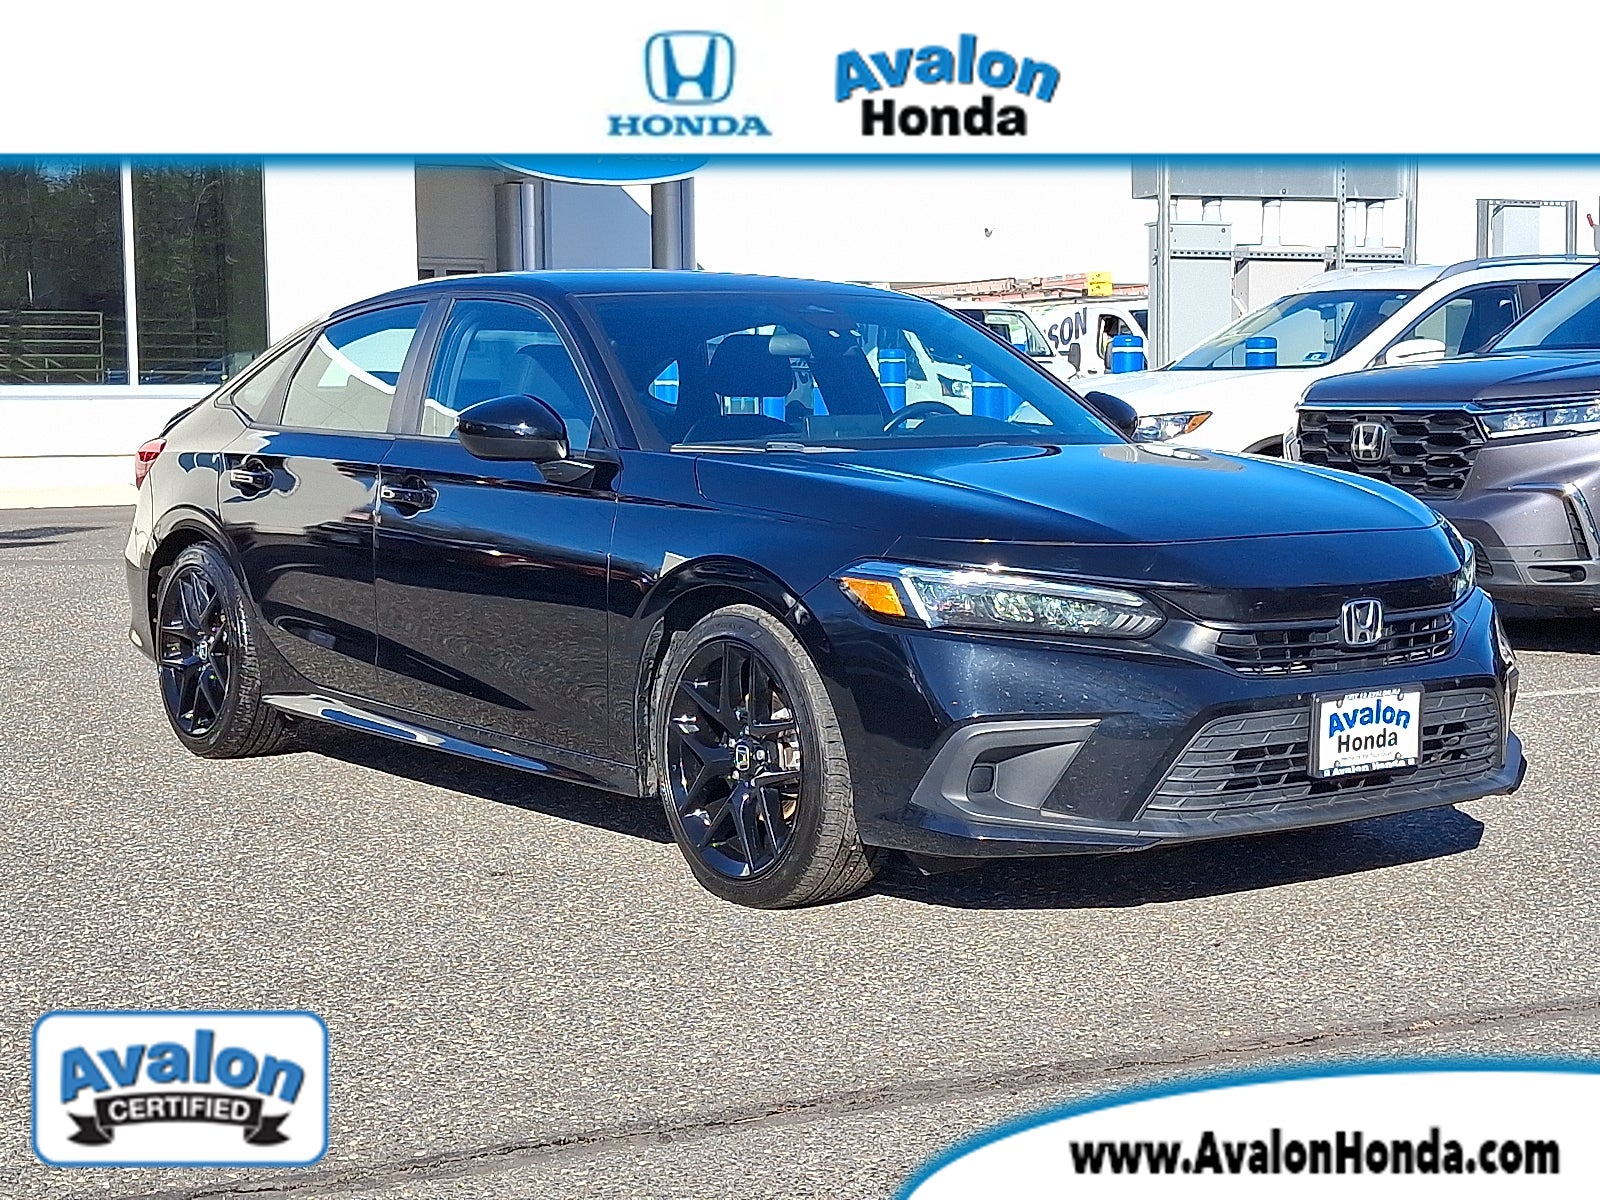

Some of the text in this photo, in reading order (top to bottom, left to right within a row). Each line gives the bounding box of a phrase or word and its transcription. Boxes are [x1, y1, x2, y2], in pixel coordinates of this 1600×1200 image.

[1043, 307, 1087, 350] SON
[1328, 699, 1411, 738] Avalon
[1337, 727, 1399, 754] Honda
